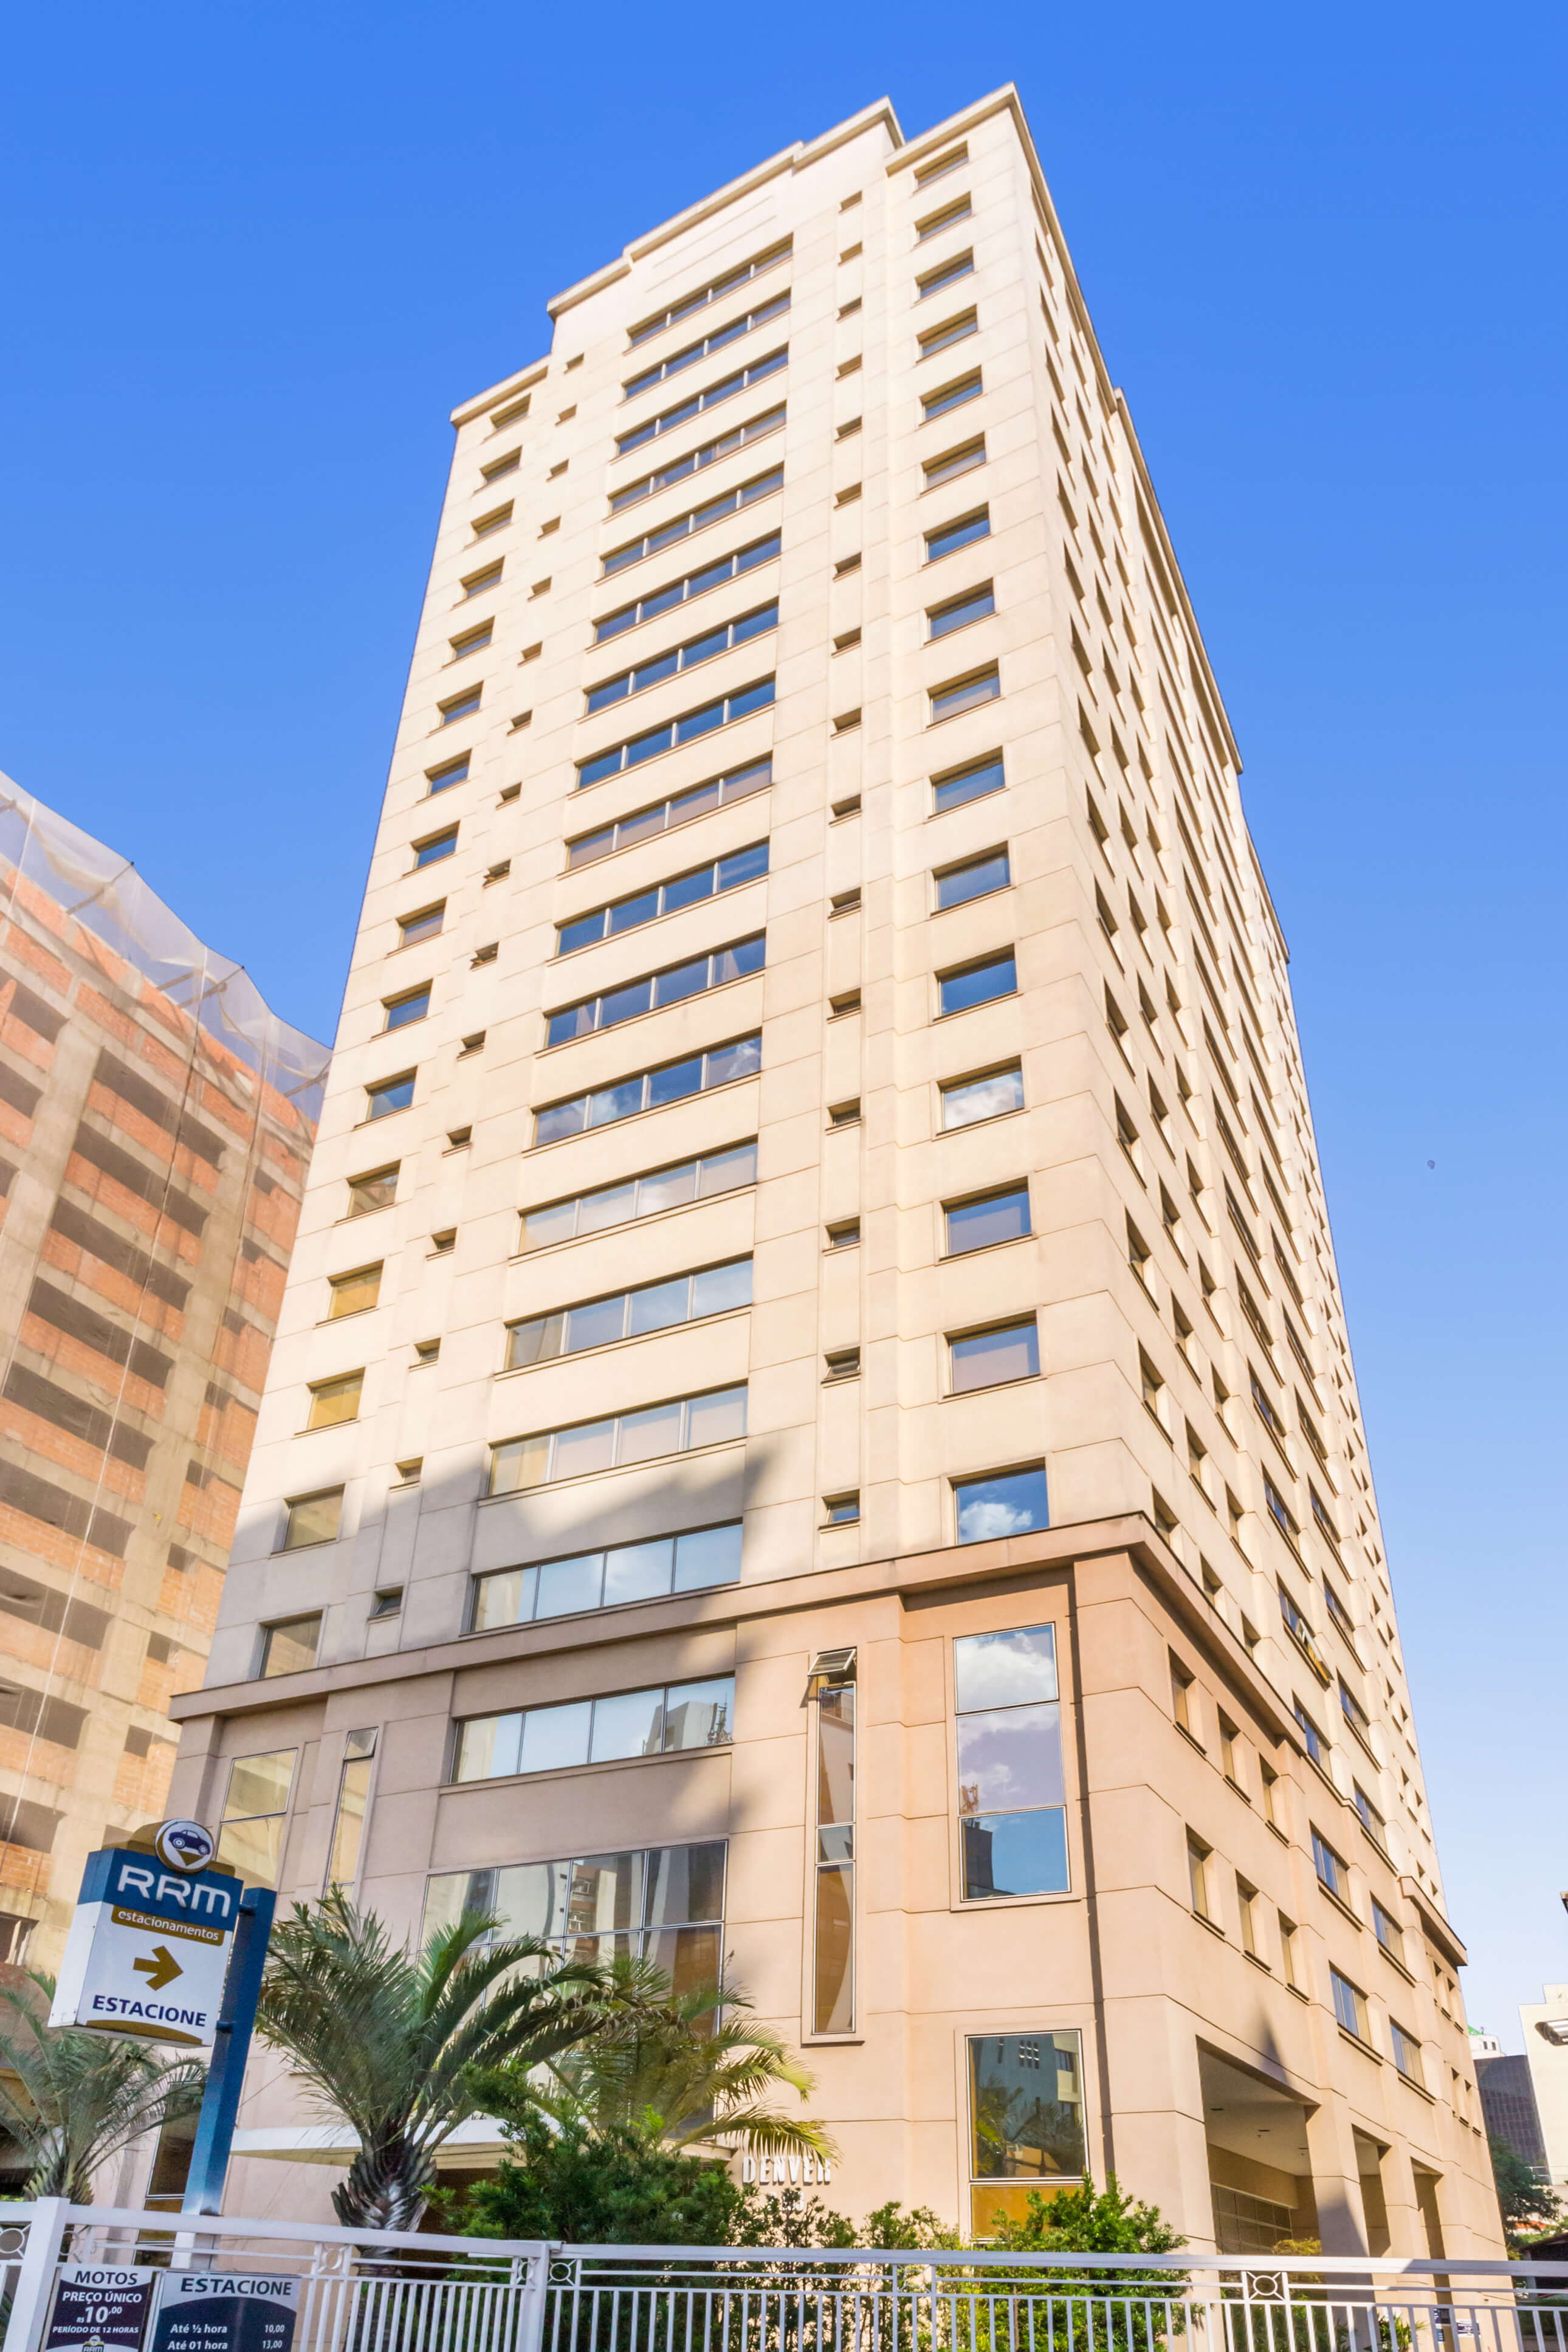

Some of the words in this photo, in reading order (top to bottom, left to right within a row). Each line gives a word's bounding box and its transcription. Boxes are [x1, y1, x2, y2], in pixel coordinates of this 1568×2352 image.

[117, 1865, 231, 1918] RRM
[117, 1910, 219, 1941] estacionamentos
[92, 1995, 207, 2027] ESTACIONE
[743, 2156, 832, 2184] DENVER
[74, 2271, 139, 2285] MOTOS
[181, 2278, 292, 2295] ESTACIONE
[62, 2291, 103, 2305] PREÇO
[105, 2291, 142, 2303] ÚNICO
[52, 2325, 89, 2334] PERÍODO
[170, 2324, 189, 2333] Até
[204, 2325, 227, 2333] hora
[265, 2325, 285, 2334] 10,00
[167, 2340, 187, 2350] Até
[189, 2341, 202, 2350] 01
[204, 2340, 228, 2350] hora
[263, 2340, 283, 2350] 13,00
